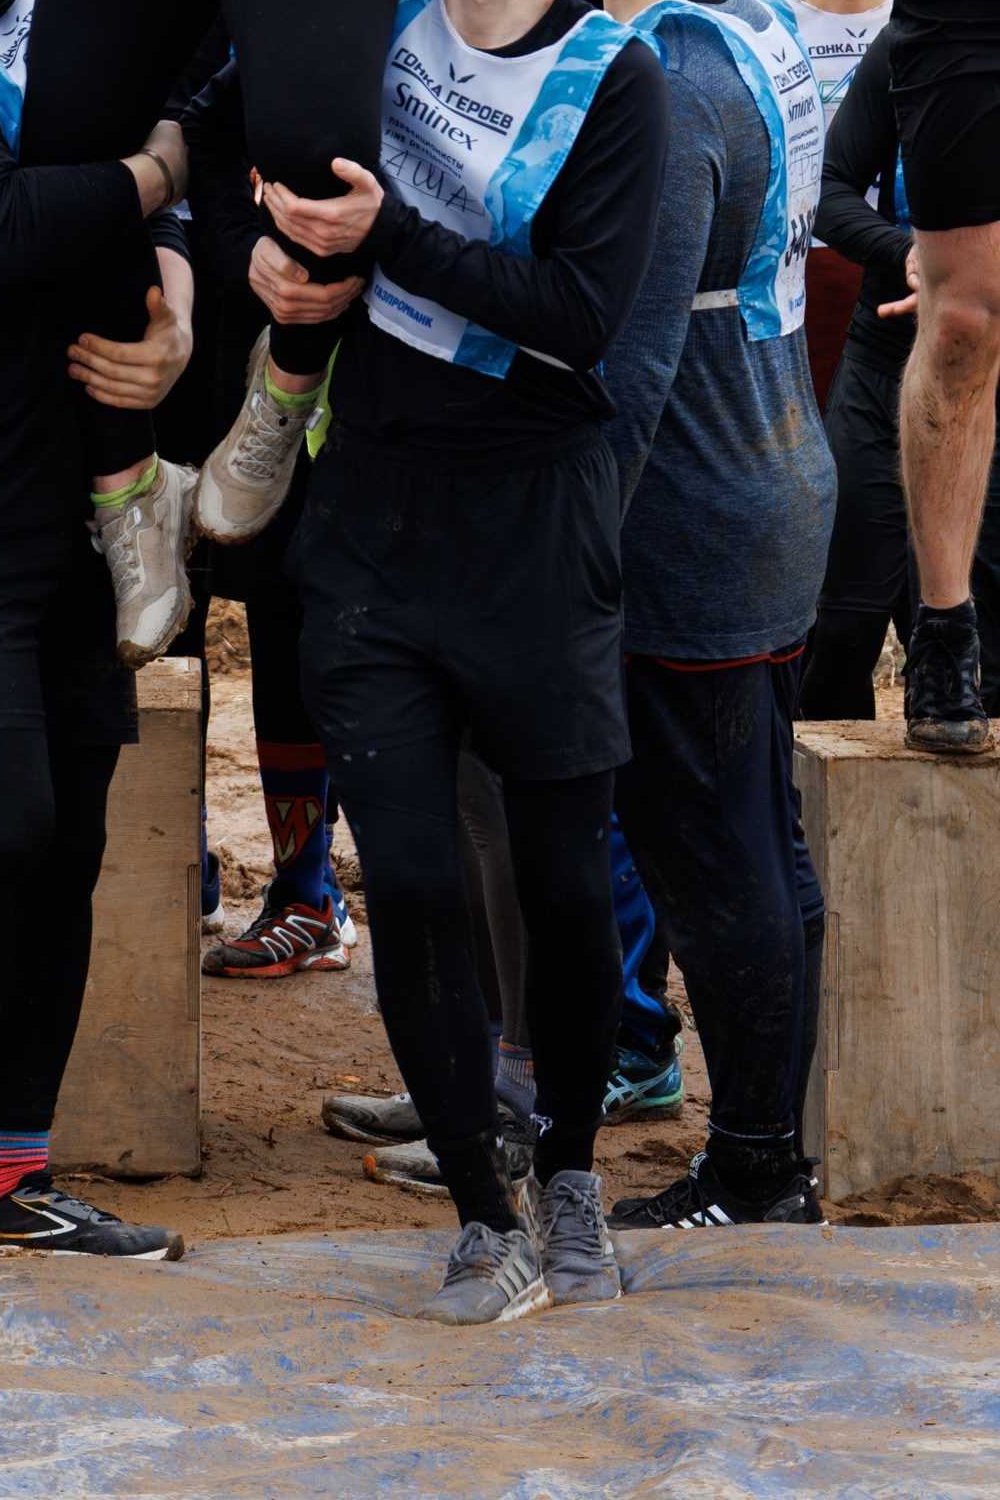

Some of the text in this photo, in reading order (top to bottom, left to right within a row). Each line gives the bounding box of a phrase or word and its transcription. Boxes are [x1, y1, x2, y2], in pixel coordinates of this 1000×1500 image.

[808, 43, 855, 56] ГОНКА
[394, 47, 514, 130] ГОНКА ГЕРОЕВ
[384, 127, 407, 144] FINE
[391, 81, 480, 152] Sminex
[373, 283, 434, 329] ГАЗПРОМБАНК
